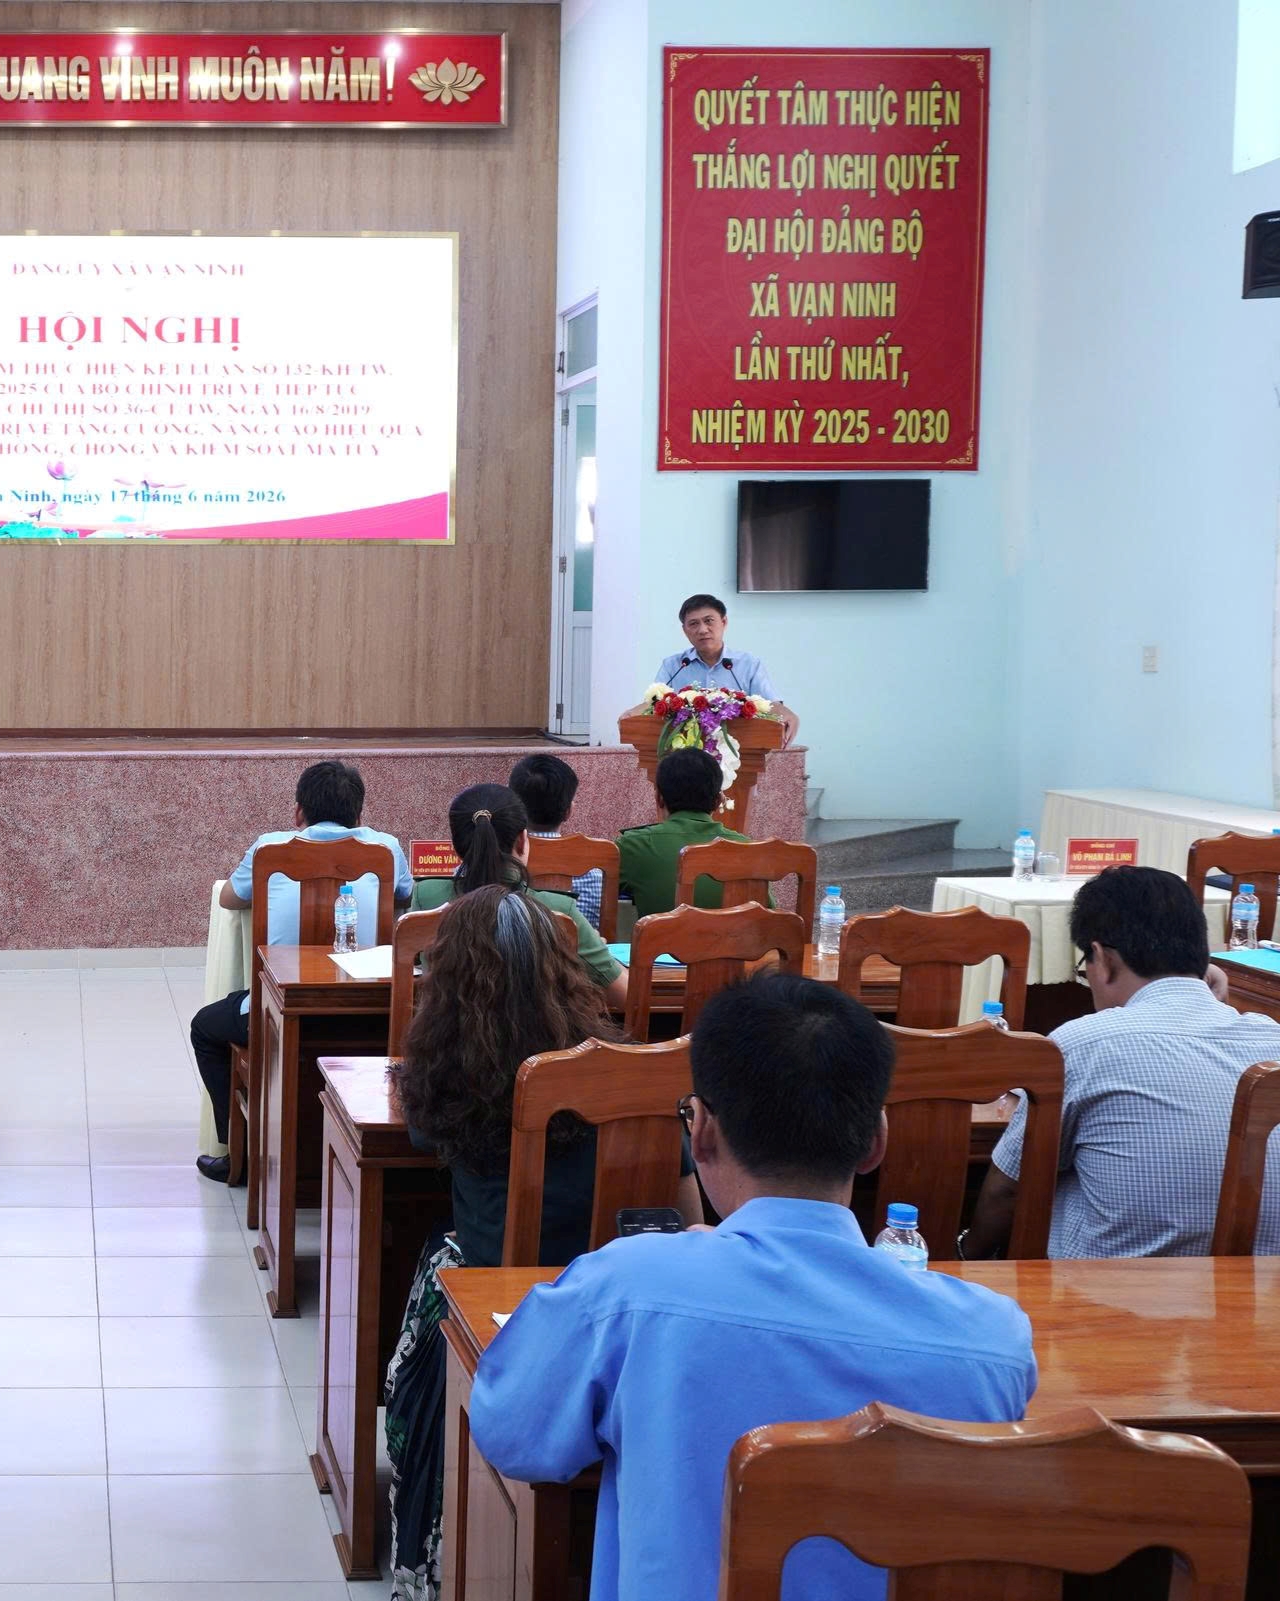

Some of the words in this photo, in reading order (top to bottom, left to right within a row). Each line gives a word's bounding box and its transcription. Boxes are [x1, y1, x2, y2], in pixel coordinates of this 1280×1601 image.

[98, 55, 179, 104] VINH
[187, 44, 293, 104] MUÔN
[300, 45, 381, 104] NĂM
[693, 75, 771, 132] QUYẾT
[776, 80, 829, 126] TÂM
[834, 83, 898, 133] THỰC
[905, 80, 960, 133] HIỆN
[692, 138, 771, 190] THẮNG
[777, 148, 816, 197] LỢI
[822, 153, 878, 198] NGHỊ
[883, 140, 960, 196] QUYẾT
[725, 217, 767, 261] ĐẠI
[773, 208, 815, 261] HỘI
[820, 204, 885, 254] ĐẢNG
[891, 209, 924, 261] BỘ
[749, 272, 780, 318] XÃ
[787, 281, 835, 325] VẠN
[840, 282, 897, 318] NINH
[19, 310, 103, 351] HỘI
[121, 316, 241, 352] NGHỊ
[734, 330, 780, 381] LẦN
[786, 336, 836, 382] THỨ
[841, 332, 909, 388] NHẤT,
[691, 399, 766, 451] NHIỆM
[773, 399, 805, 444] KỲ
[812, 408, 870, 444] 2025
[891, 408, 950, 444] 2030
[188, 490, 197, 502] 6
[247, 490, 286, 503] 2026
